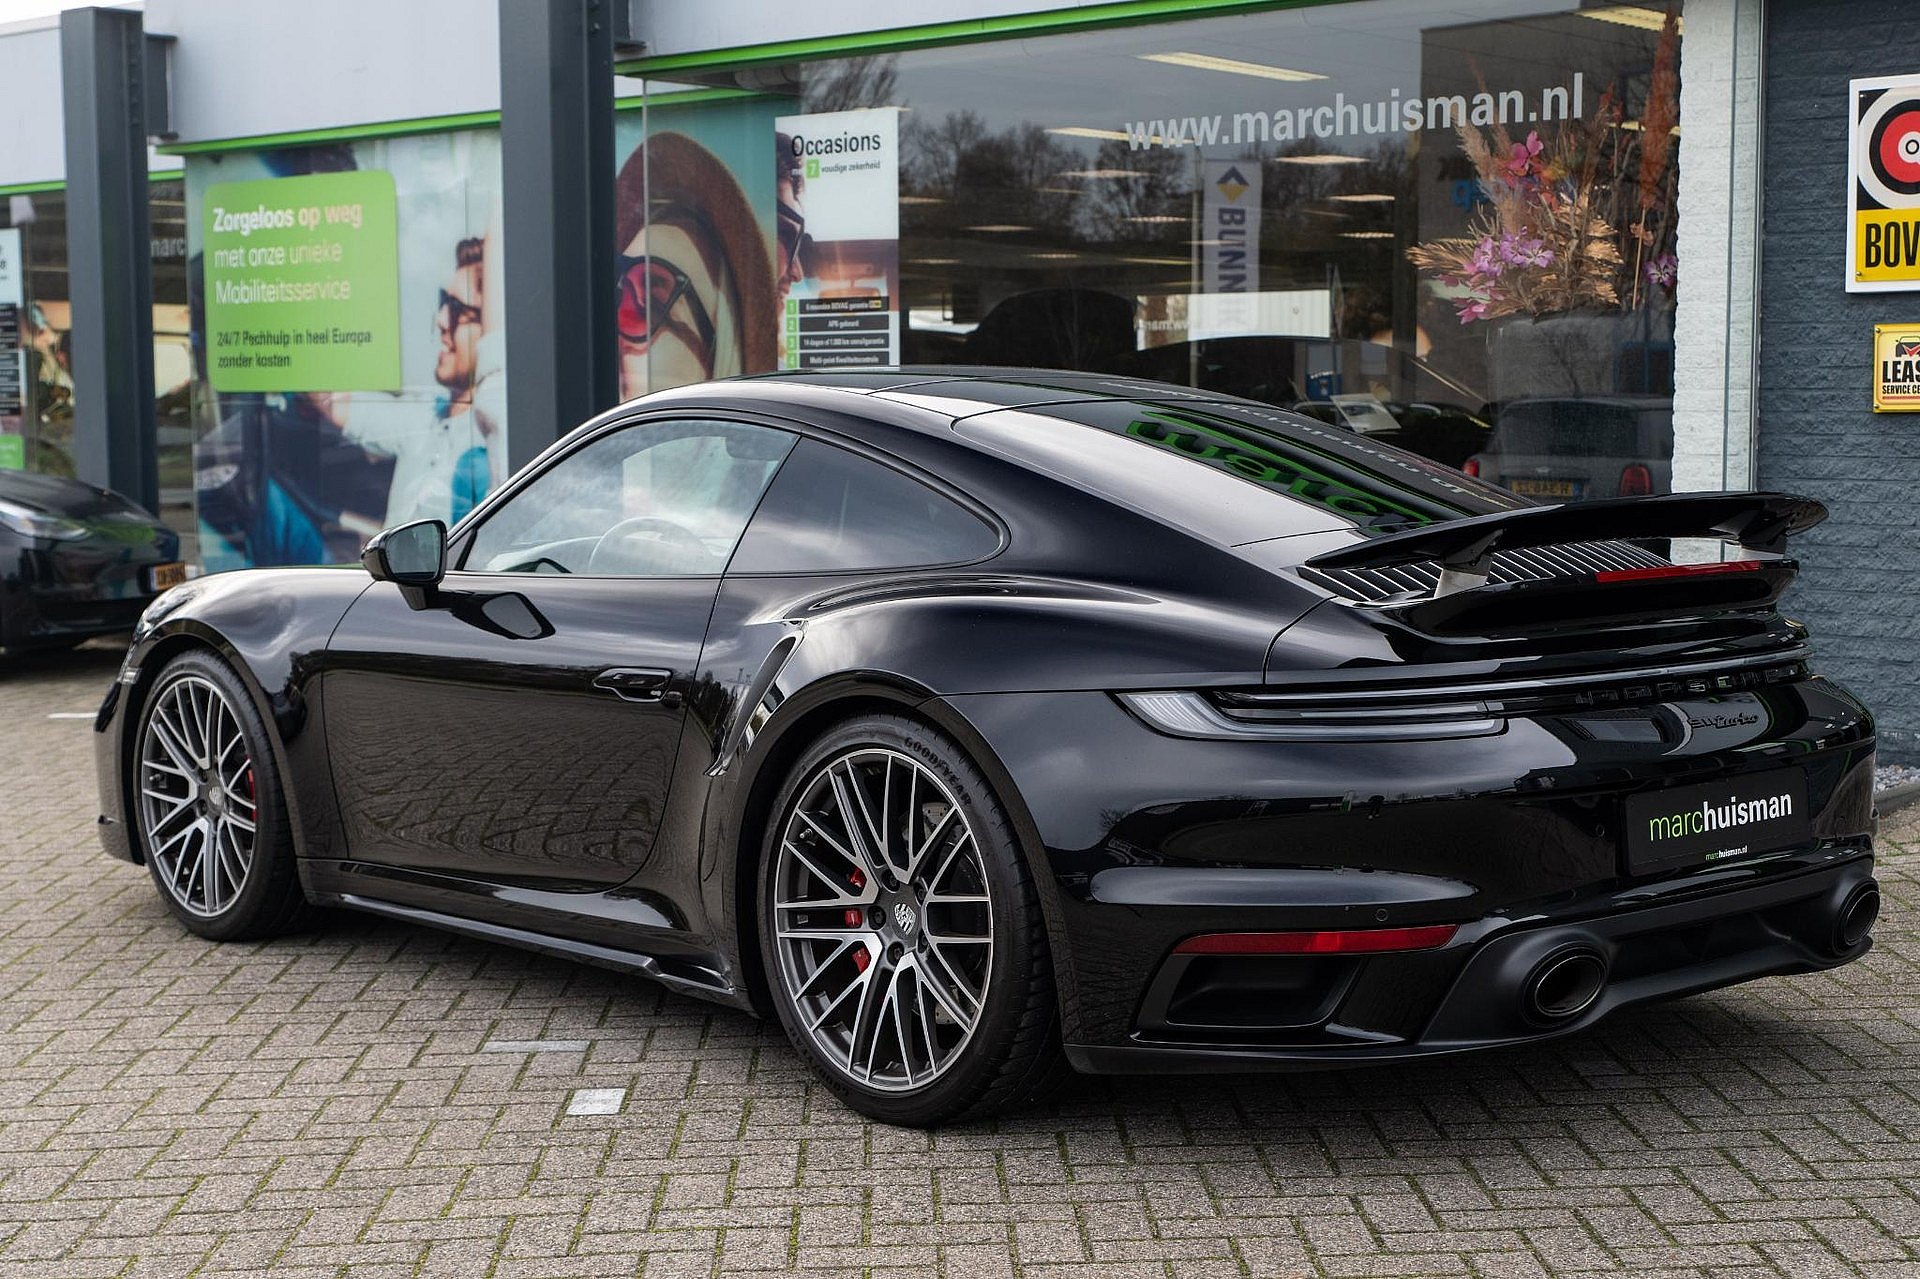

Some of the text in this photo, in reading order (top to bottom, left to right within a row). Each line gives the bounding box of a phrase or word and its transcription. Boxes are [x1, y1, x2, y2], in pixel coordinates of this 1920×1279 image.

[1125, 72, 1584, 151] www.marchuisman.nl
[791, 131, 881, 157] Occasions
[821, 163, 847, 173] voudige
[848, 160, 881, 171] zekerheid
[212, 203, 362, 237] Zorgeloos op weg
[214, 240, 342, 268] met onze unieke
[1865, 220, 1920, 269] BOV
[215, 275, 350, 304] Mobiliteitsservice
[216, 327, 371, 348] 24/7 Pechhulp in heel Europa
[218, 352, 290, 369] zonder kosten
[1882, 385, 1911, 394] SERVICE
[1649, 793, 1792, 841] marchuisman
[1705, 844, 1748, 860] marchuisman.nl
